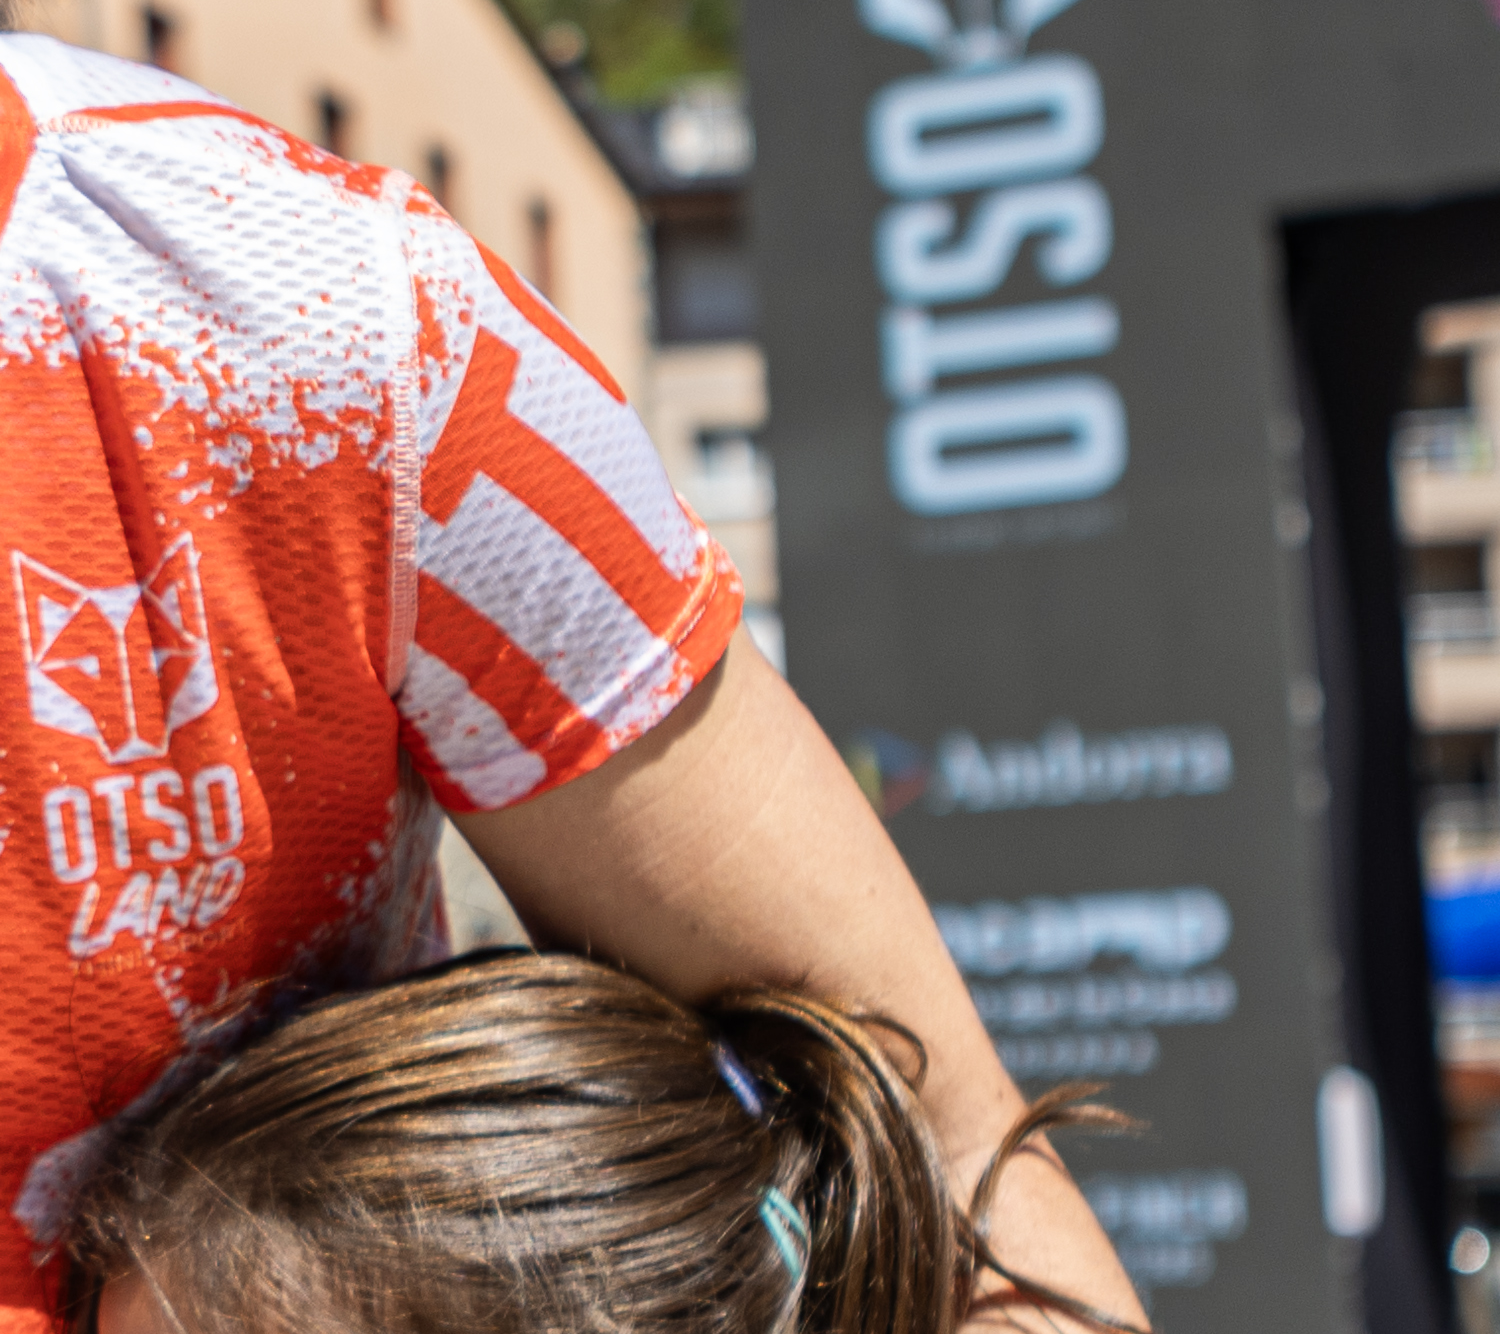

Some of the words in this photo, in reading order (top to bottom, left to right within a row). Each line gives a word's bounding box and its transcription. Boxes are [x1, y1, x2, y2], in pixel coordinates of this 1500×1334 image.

[865, 50, 1130, 517] OTSO
[41, 763, 246, 884] OTSO
[66, 855, 247, 957] LAND
